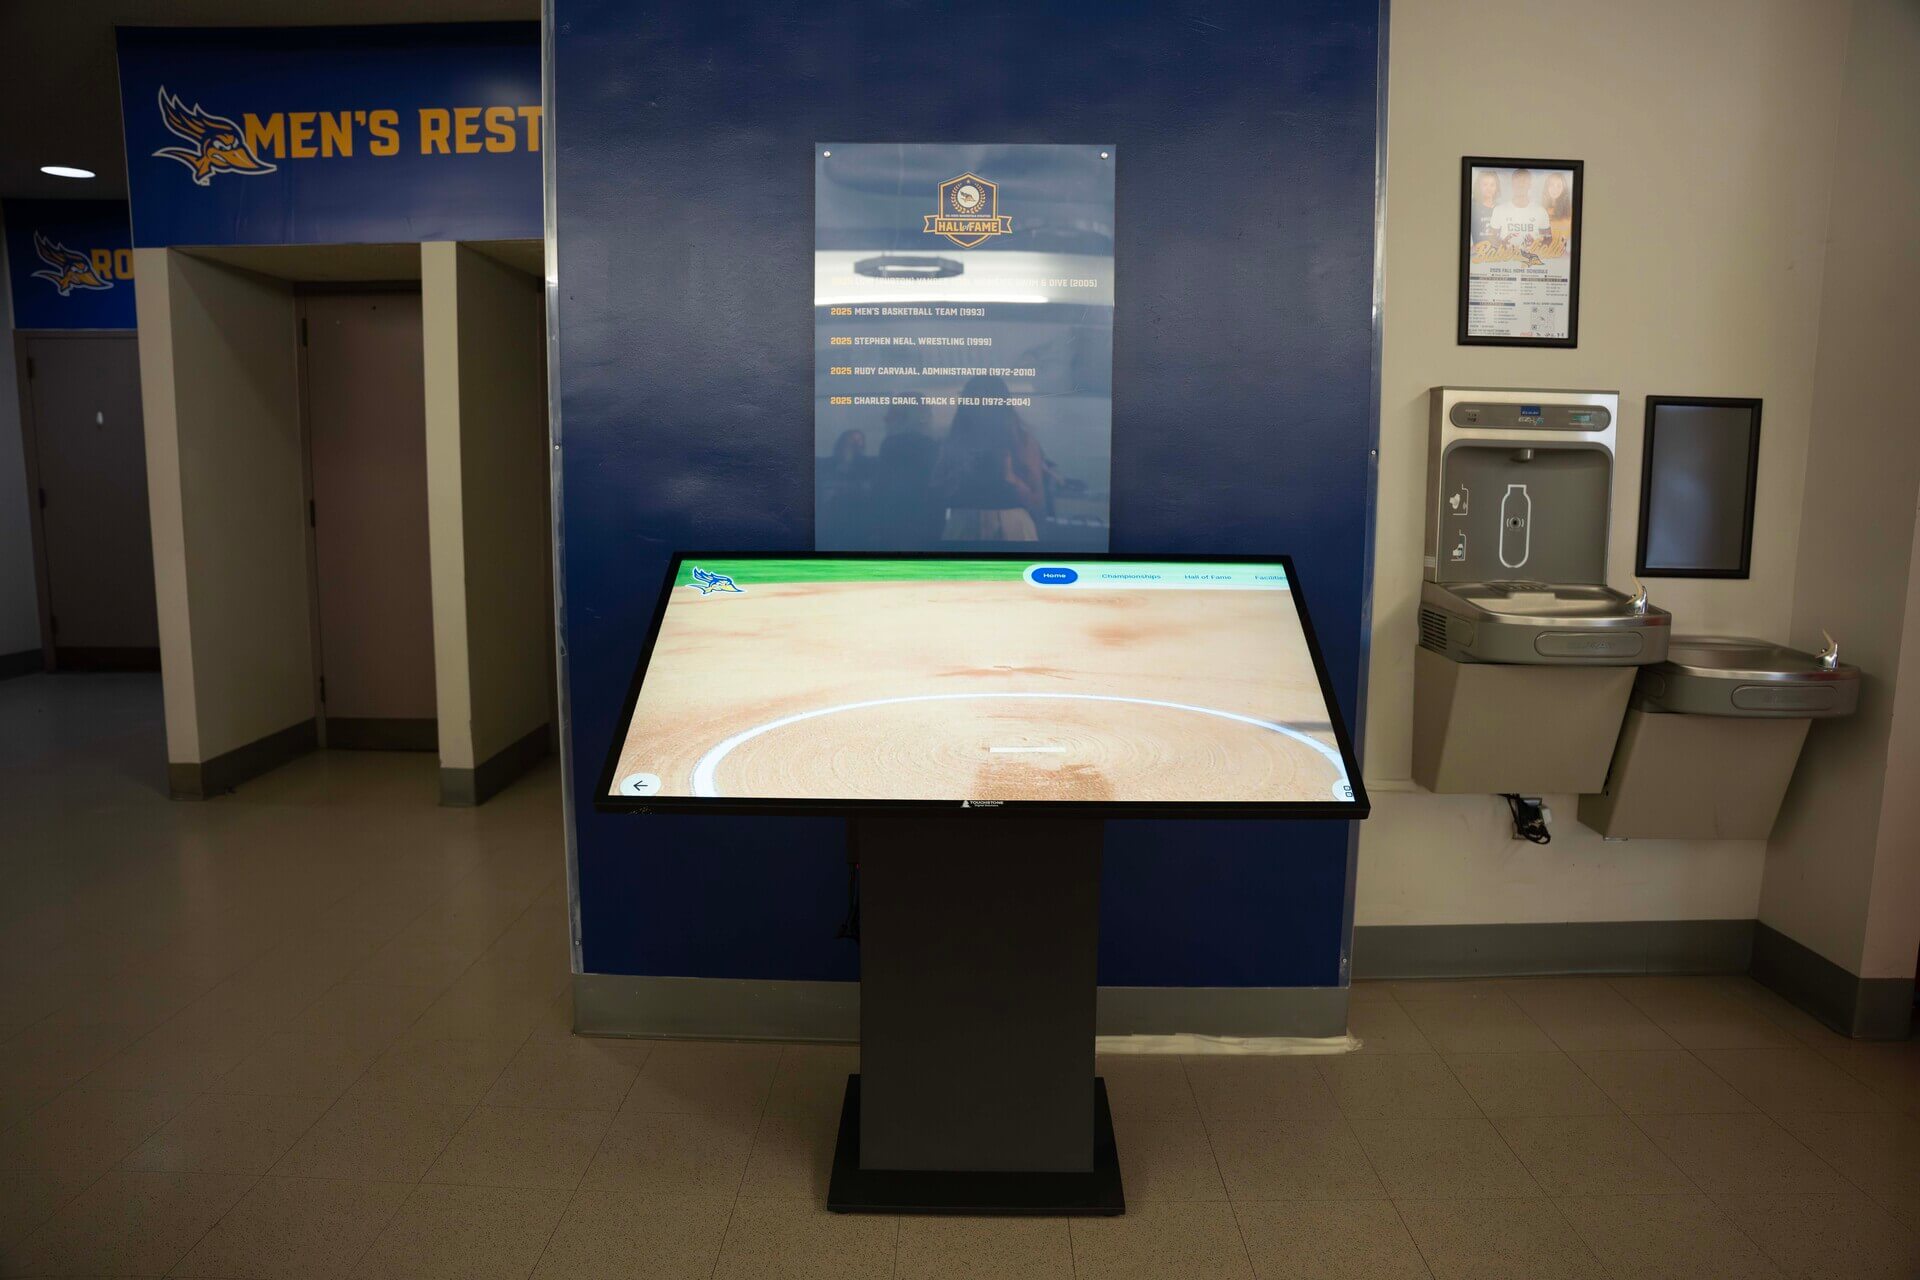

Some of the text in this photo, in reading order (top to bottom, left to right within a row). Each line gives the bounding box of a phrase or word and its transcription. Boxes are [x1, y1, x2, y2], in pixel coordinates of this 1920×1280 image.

[243, 106, 543, 158] MEN'S REST
[938, 221, 963, 232] HALL
[968, 221, 998, 232] FAME
[1507, 223, 1534, 232] CSUB
[90, 249, 134, 280] RO
[1049, 279, 1068, 287] DIVE
[1070, 279, 1098, 288] (2005)
[830, 307, 985, 317] 2025 MEN'S BASKETBALL TEAM (1993)
[830, 337, 992, 346] 2025 STEPHEN NEAL, WRESTLING (1999)
[830, 366, 1036, 377] 2025 RUDY CARVAJAL, ADMINISTRATOR (1972-2010)
[830, 396, 852, 405] 2025
[854, 396, 890, 405] CHARLES
[892, 397, 919, 406] CRAIG,
[921, 397, 948, 405] TRACK
[957, 397, 980, 406] FIELD
[982, 397, 1031, 407] (1972-2004)
